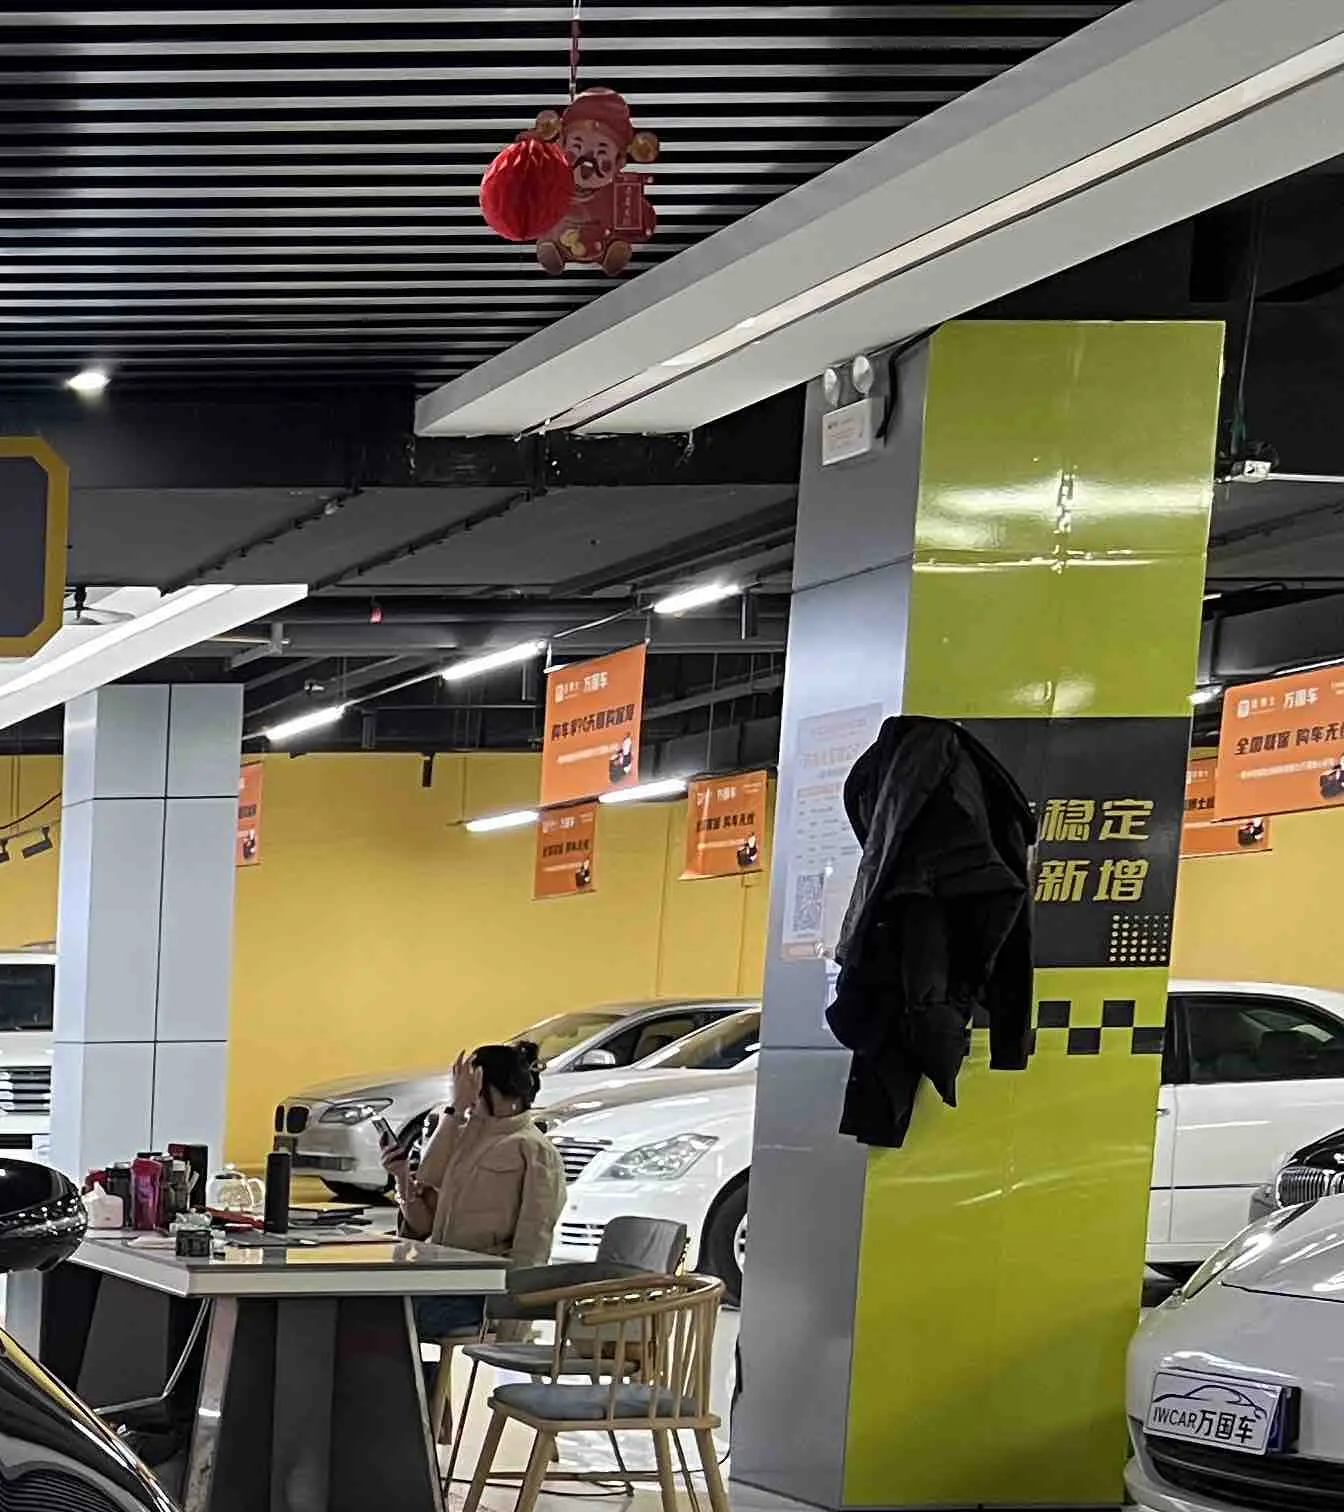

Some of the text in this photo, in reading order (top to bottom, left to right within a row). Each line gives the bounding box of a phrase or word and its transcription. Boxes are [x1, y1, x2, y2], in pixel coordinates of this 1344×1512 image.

[1040, 799, 1154, 840] 稳定
[1034, 859, 1150, 902] 新增
[1152, 1406, 1257, 1443] IWCAR万国车
